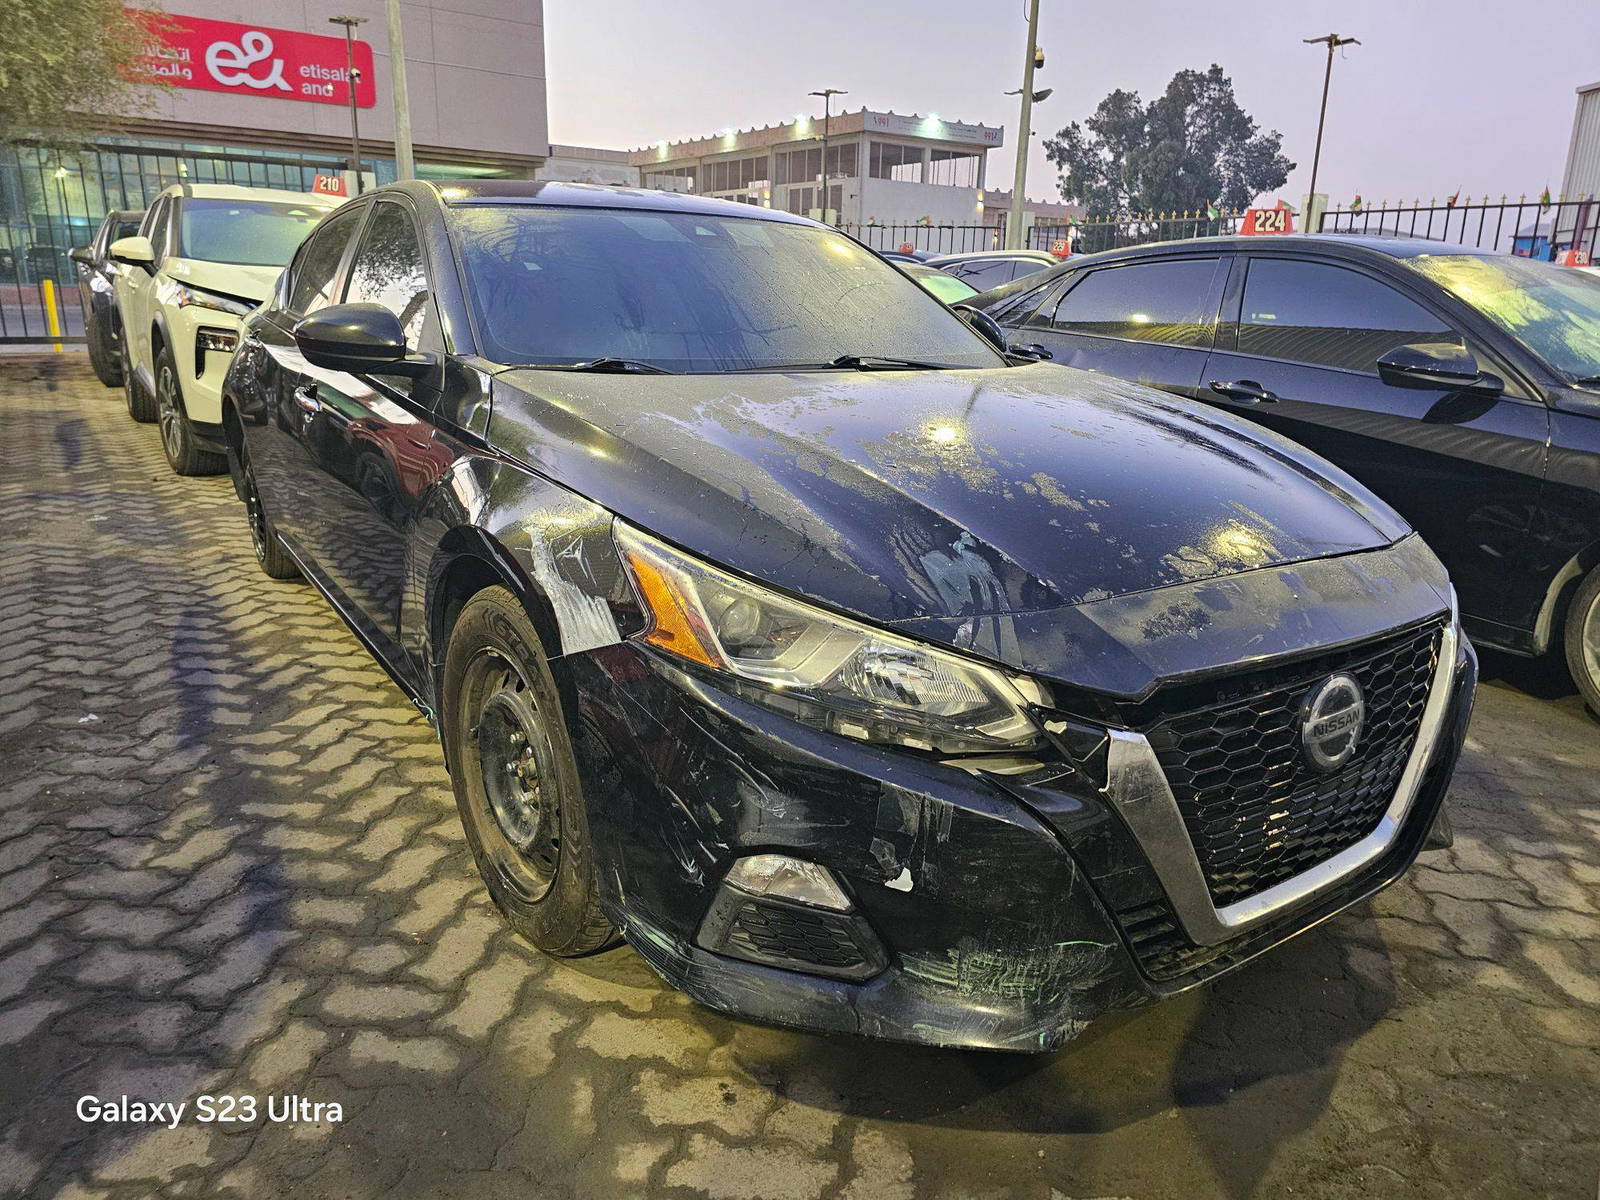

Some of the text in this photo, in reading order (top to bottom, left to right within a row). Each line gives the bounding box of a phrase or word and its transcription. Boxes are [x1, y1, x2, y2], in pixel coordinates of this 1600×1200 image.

[302, 82, 334, 97] and
[319, 175, 340, 193] 210
[1255, 210, 1285, 232] 224
[1313, 709, 1360, 736] NISSAN
